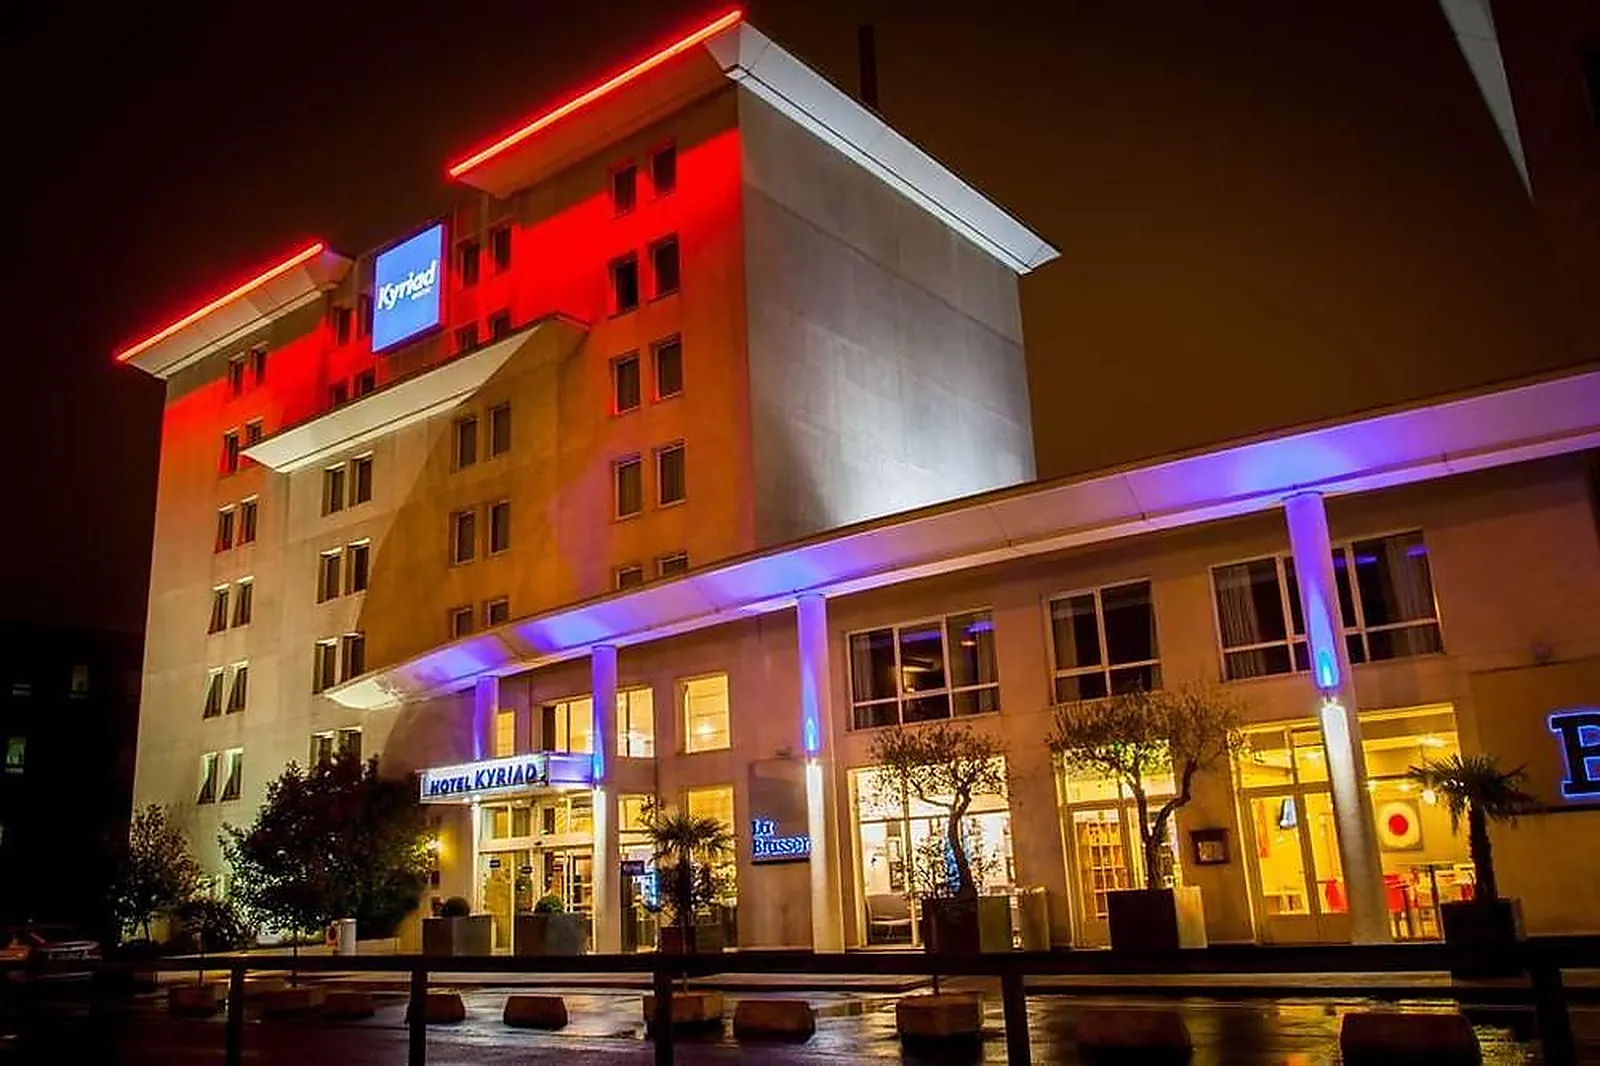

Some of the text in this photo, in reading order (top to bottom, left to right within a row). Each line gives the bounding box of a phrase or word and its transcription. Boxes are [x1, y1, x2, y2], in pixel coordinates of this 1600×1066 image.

[377, 259, 437, 310] Kyriad
[429, 763, 537, 795] HOTEL KYRIAD
